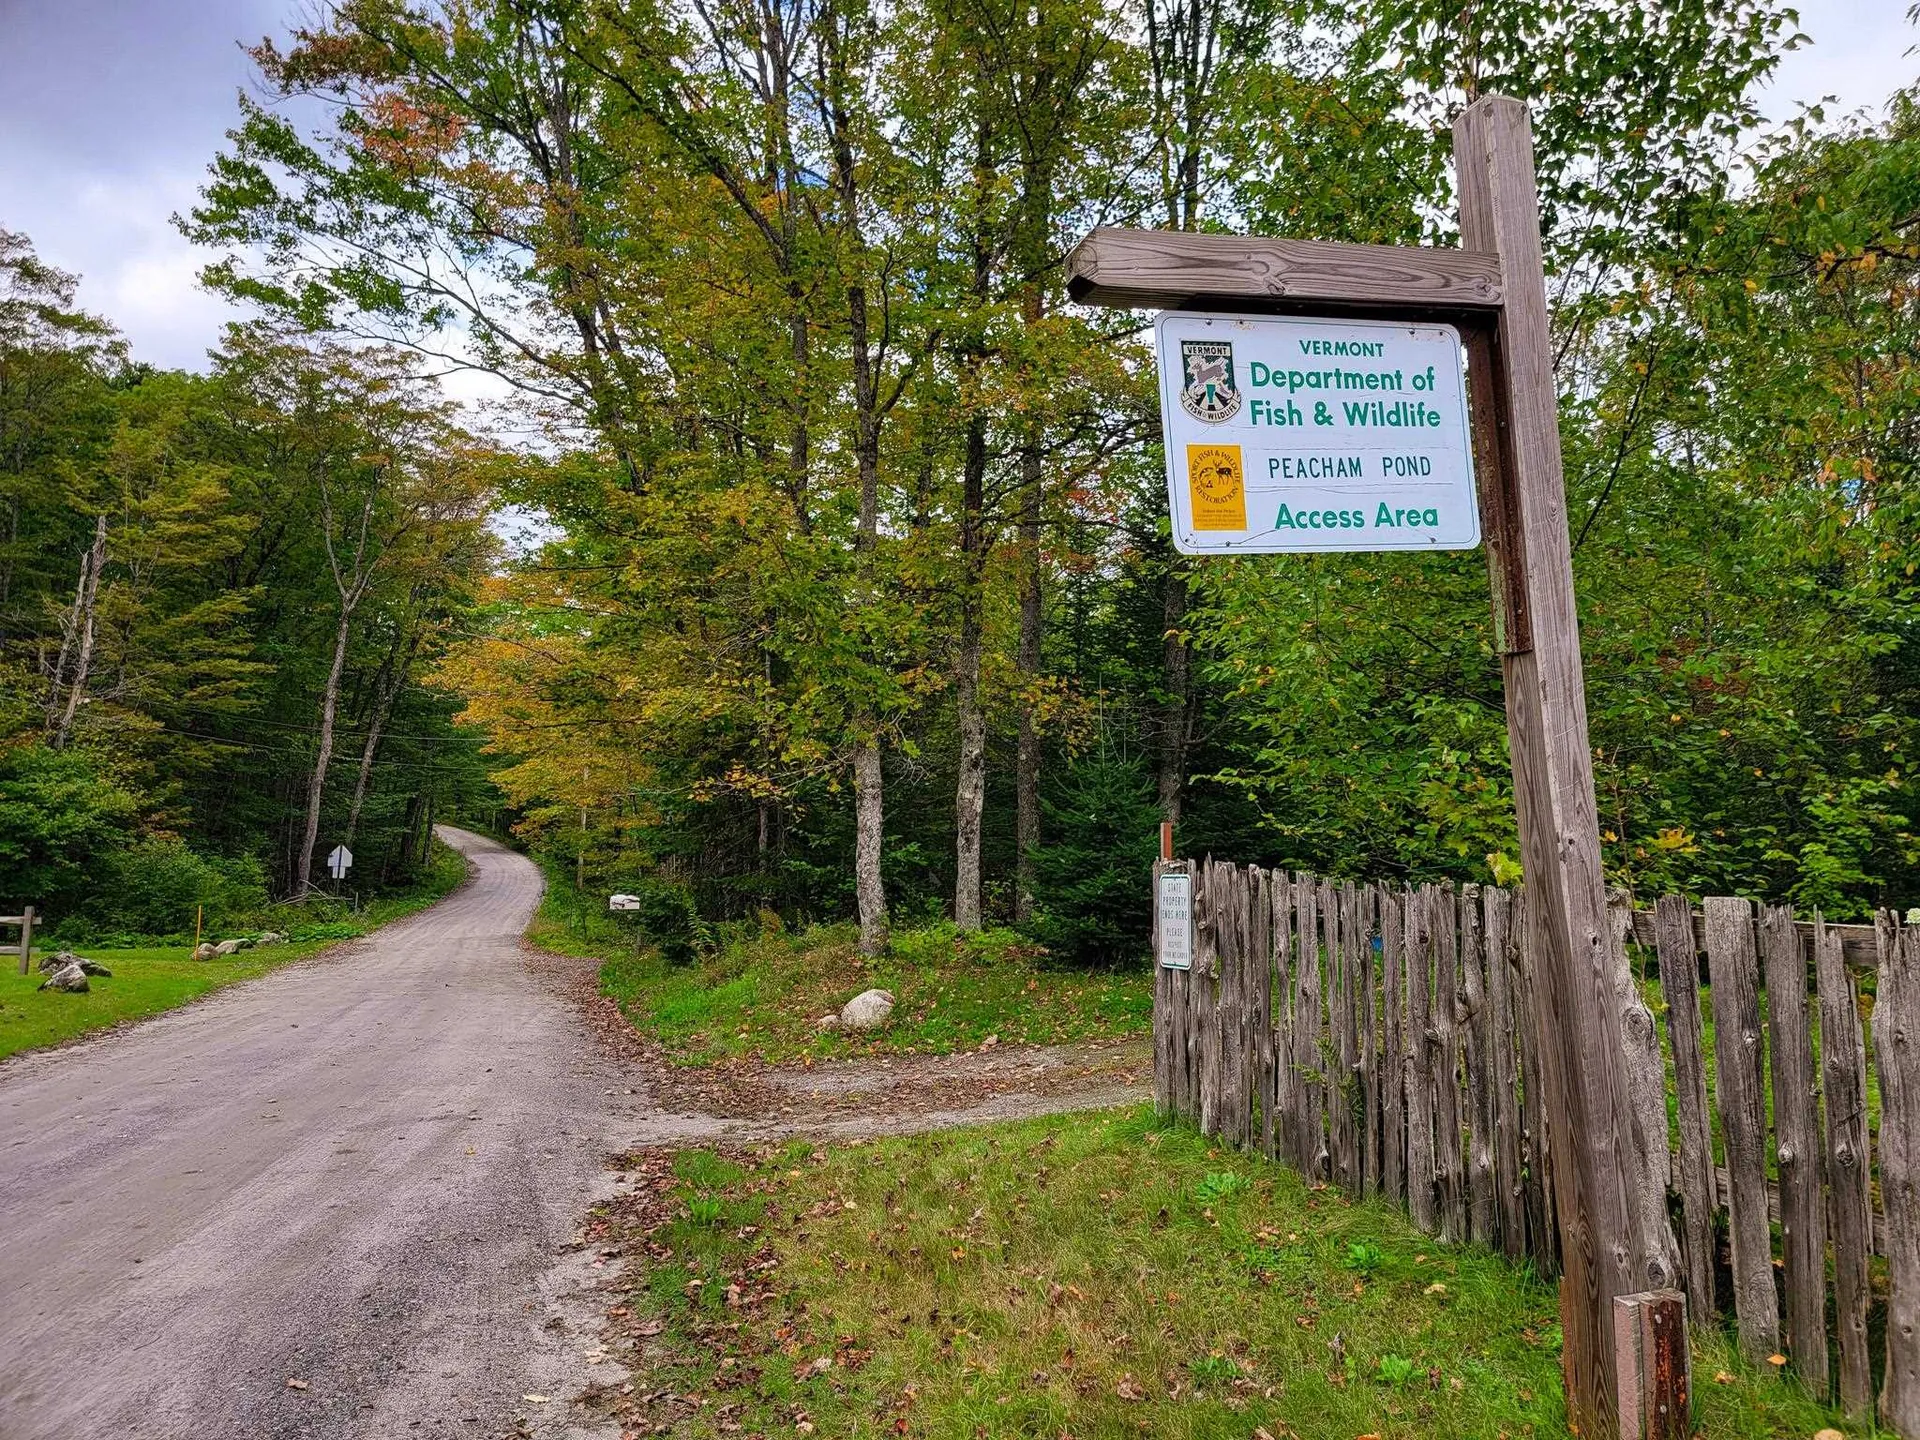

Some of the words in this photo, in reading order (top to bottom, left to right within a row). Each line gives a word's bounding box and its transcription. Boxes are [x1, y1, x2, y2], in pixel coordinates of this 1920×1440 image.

[1187, 346, 1227, 355] VERMONT
[1299, 340, 1384, 357] VERMONT
[1250, 362, 1403, 394] Department
[1412, 366, 1435, 391] of
[1187, 402, 1203, 417] FISH
[1207, 403, 1238, 420] WILDLIFE
[1250, 400, 1304, 426] Fish
[1313, 401, 1334, 426] &
[1343, 401, 1441, 427] Wildlife
[1199, 449, 1213, 462] FISH
[1268, 457, 1362, 479] PEACHAM
[1382, 456, 1431, 477] POND
[1274, 503, 1365, 529] Access
[1375, 502, 1439, 528] Area
[1167, 883, 1182, 893] STATE
[1162, 896, 1187, 907] PROPERTY
